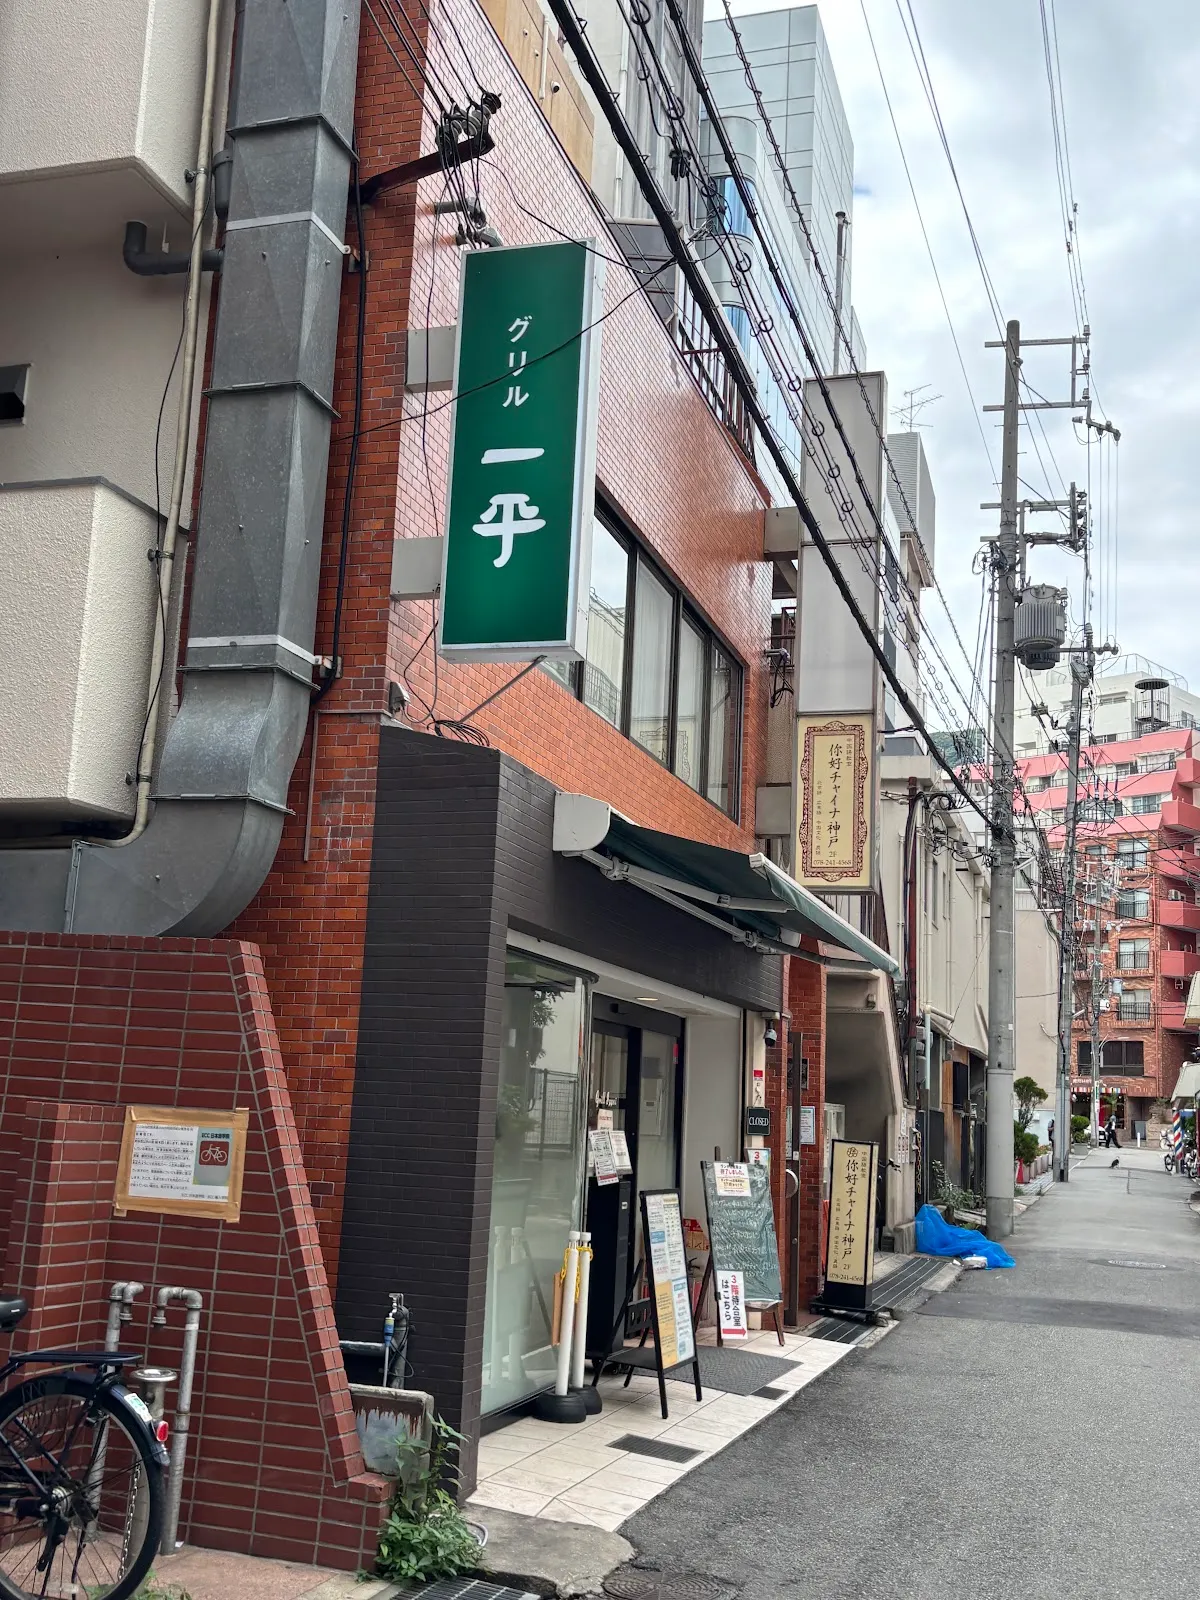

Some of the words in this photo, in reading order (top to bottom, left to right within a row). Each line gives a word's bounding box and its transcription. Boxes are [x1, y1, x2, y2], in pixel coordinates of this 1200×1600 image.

[502, 315, 533, 408] グリル
[472, 447, 547, 568] 一平
[826, 743, 843, 848] 你好チャイナ神戸
[748, 1117, 769, 1126] CLOSED
[841, 1159, 859, 1260] 你好チャイナ神戸
[721, 1279, 732, 1321] はこちら
[843, 1263, 851, 1271] 2F
